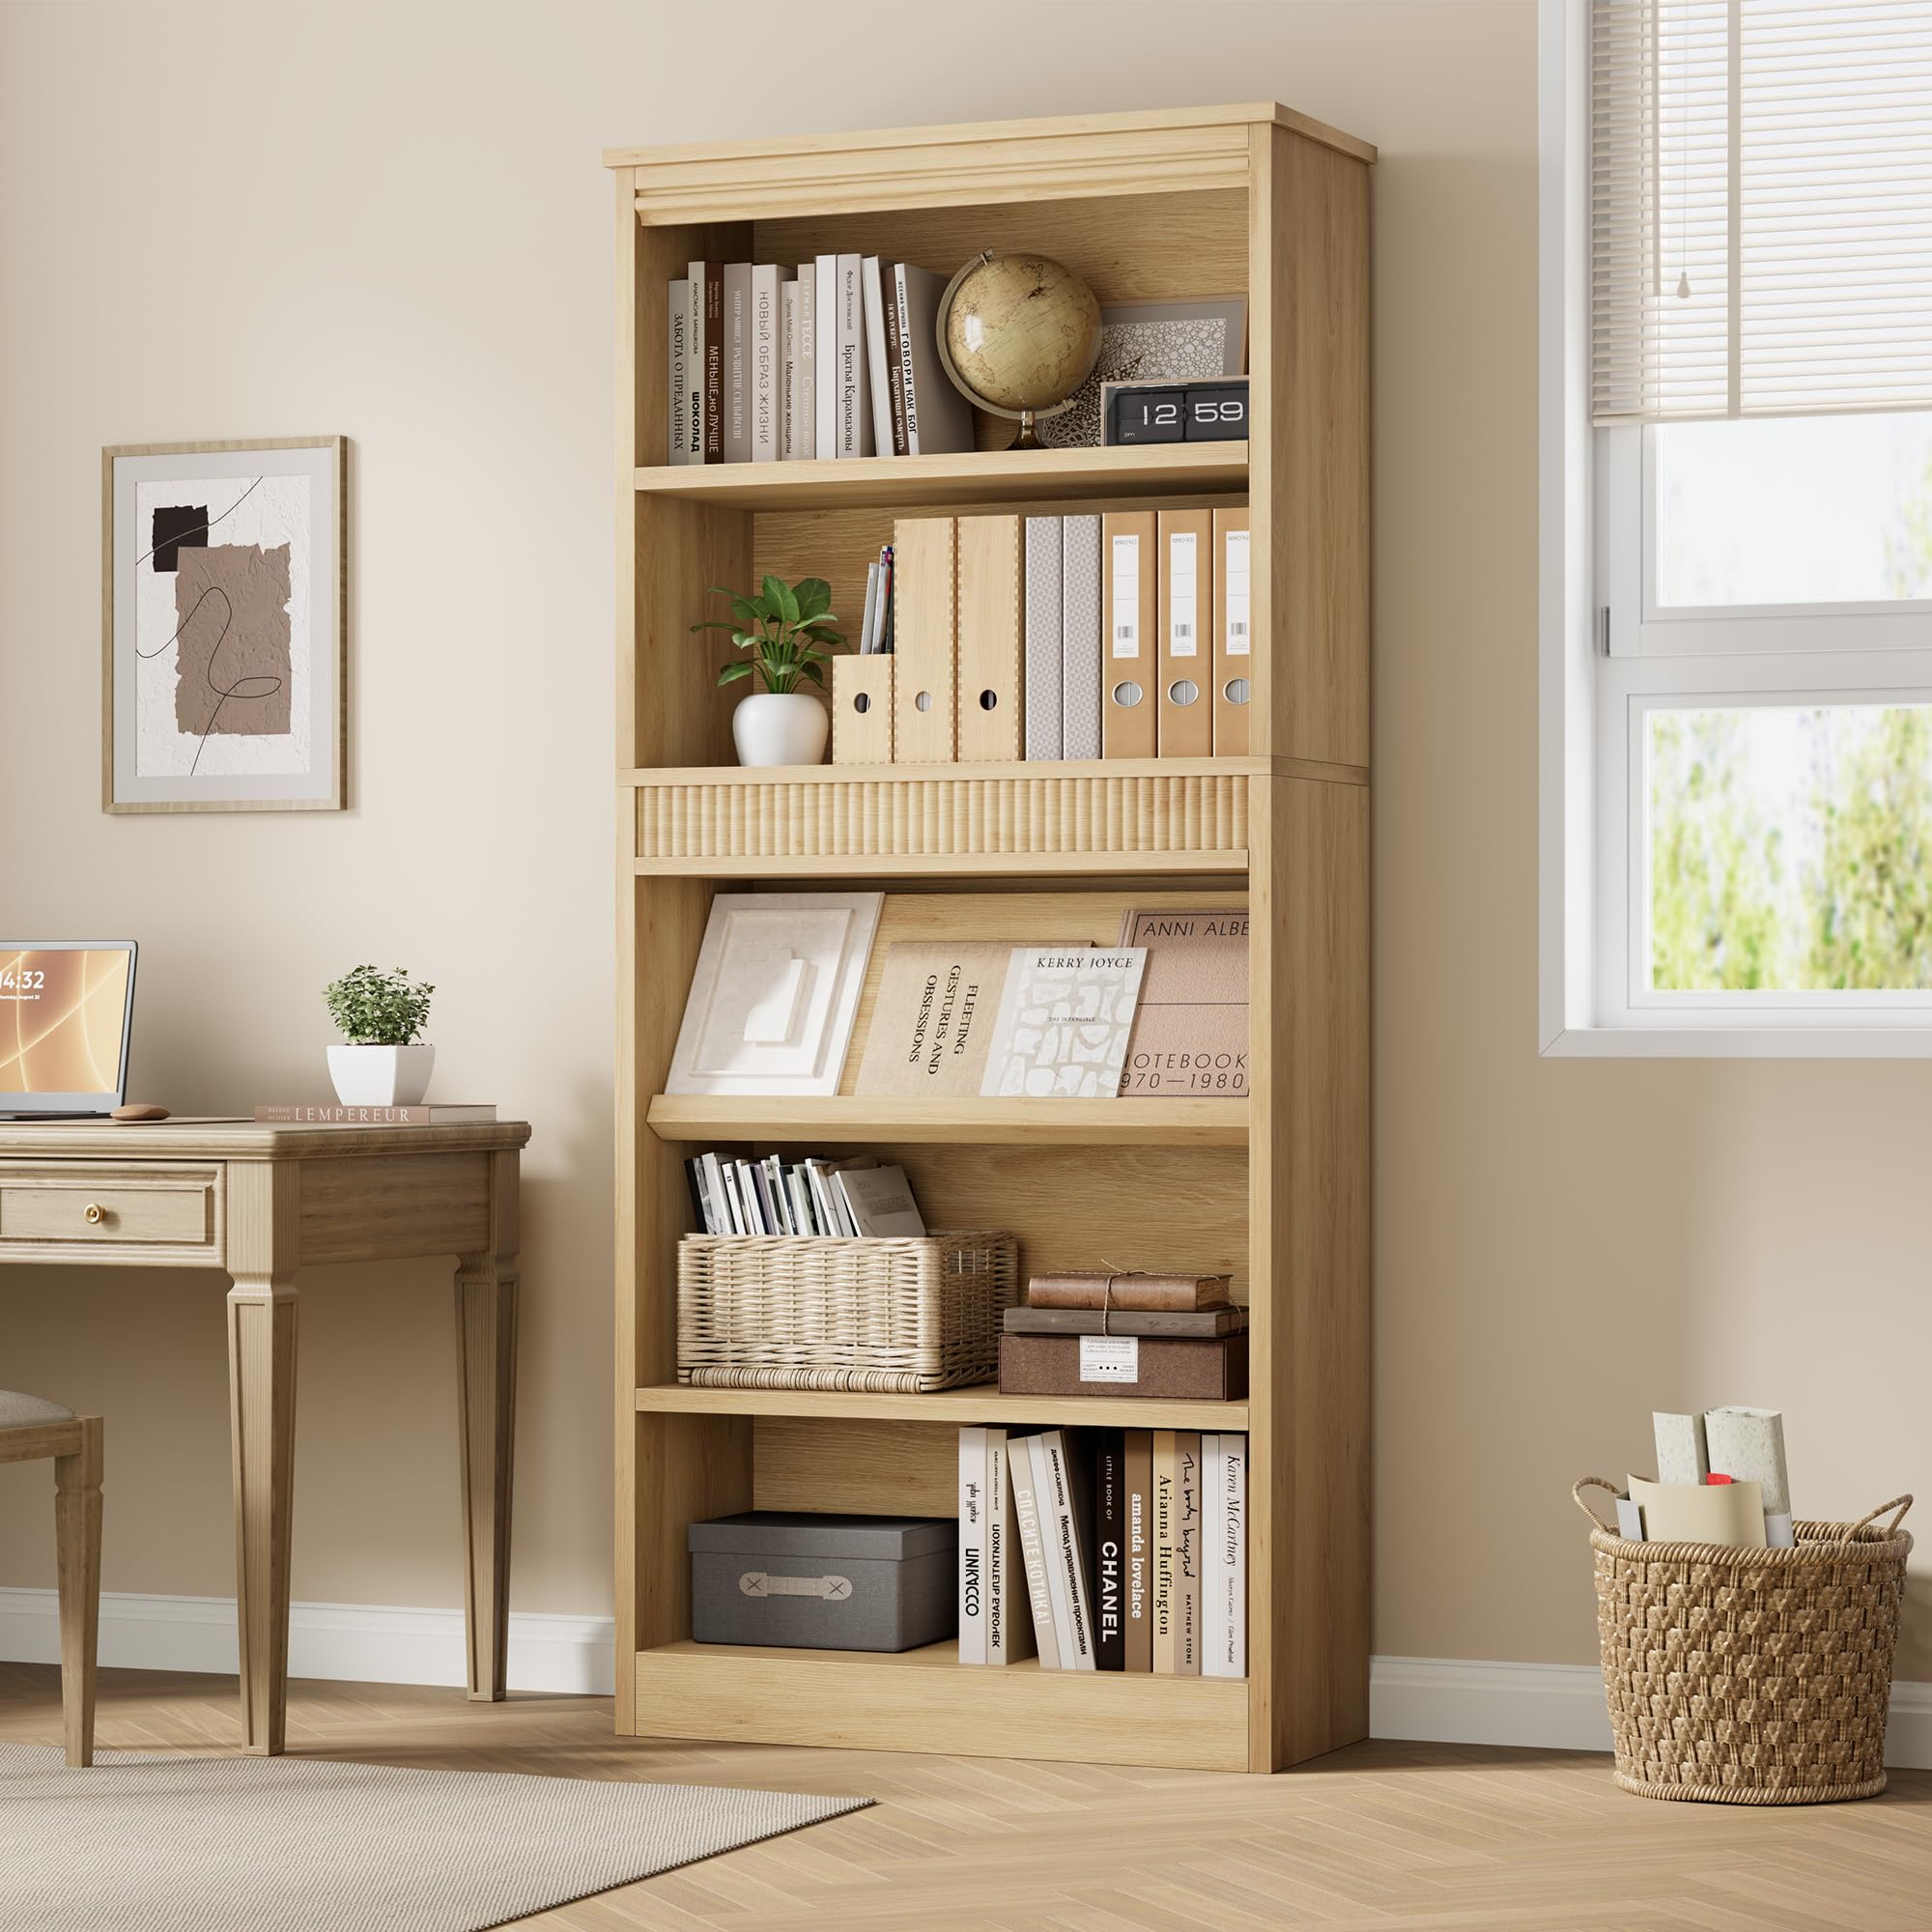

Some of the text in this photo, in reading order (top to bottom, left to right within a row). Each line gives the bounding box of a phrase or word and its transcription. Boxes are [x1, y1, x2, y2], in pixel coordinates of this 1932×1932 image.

[733, 347, 742, 390] РАЗВИТИЕ
[759, 292, 770, 443] НОВЫЙ ОБРАЗ ЖИЗНИ
[803, 320, 812, 359] ГЕССЕ
[901, 333, 912, 385] ГОВОРИ
[673, 313, 683, 449] ЗАБОТА О ПРЕДАННЫХ
[842, 344, 855, 451] Братья Карамазовы
[892, 366, 905, 450] Бархатная смерть
[905, 389, 914, 410] КАК
[1144, 401, 1244, 426] 12 59
[691, 392, 699, 452] ШОКОЛАД
[709, 413, 718, 452] ЛУЧШЕ
[1037, 956, 1134, 969] KERRY JOYCE
[1144, 922, 1195, 936] ANNI
[909, 974, 938, 1063] OBSESSIONS
[927, 965, 961, 1075] GESTURES AND
[953, 983, 979, 1055] FLEETING
[296, 1107, 410, 1122] LEMPEREUR
[1051, 1449, 1065, 1506] ДЖЕФФ САЗЕРЛЕНД
[1106, 1510, 1112, 1520] OF
[1177, 1454, 1198, 1578] The body beyond
[1223, 1456, 1239, 1566] Karen McCartney
[1018, 1490, 1050, 1625] СПАСИТЕ КОТИКА!
[1060, 1515, 1070, 1545] Метод
[1072, 1605, 1087, 1655] проектами
[1102, 1542, 1117, 1642] CHANEL
[1131, 1493, 1144, 1618] amanda lovelace
[1156, 1475, 1172, 1635] Arianna Huffington
